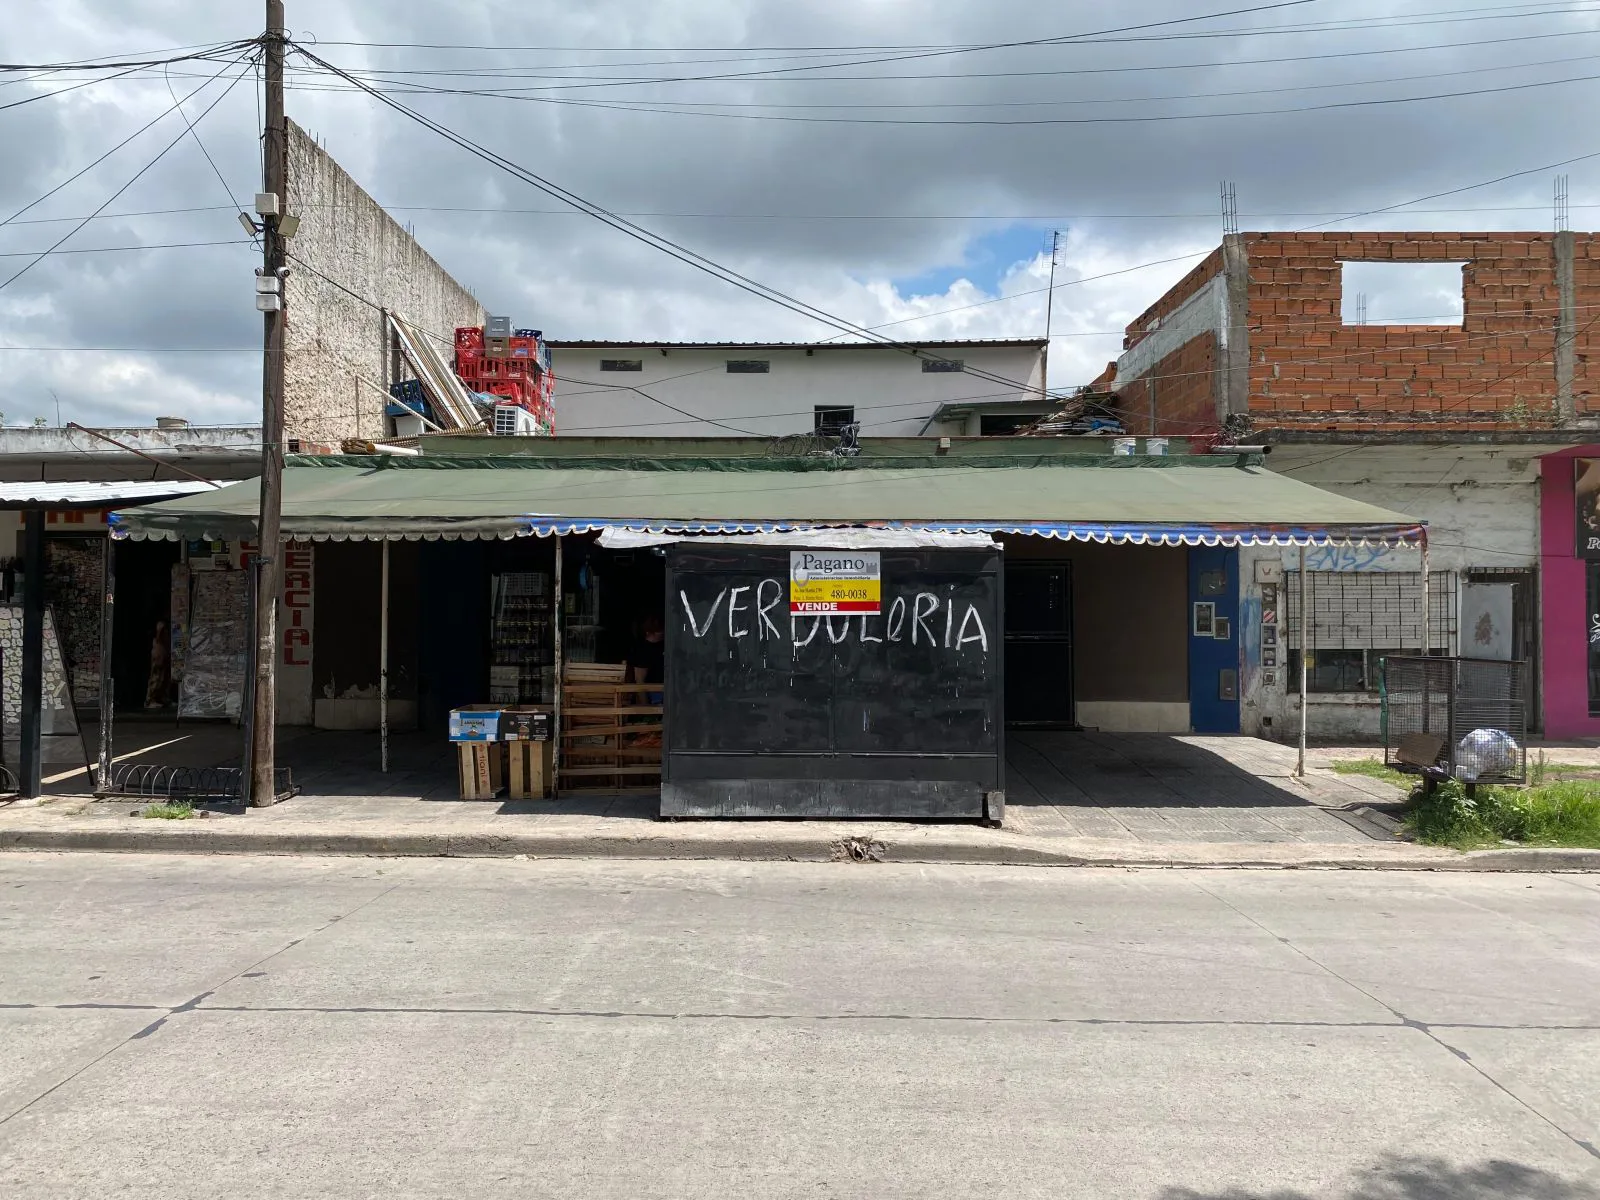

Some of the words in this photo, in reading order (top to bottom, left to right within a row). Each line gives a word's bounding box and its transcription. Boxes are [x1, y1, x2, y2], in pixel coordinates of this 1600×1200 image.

[802, 554, 864, 573] Pagano
[831, 589, 867, 599] 480-0038
[797, 602, 838, 611] VENDE
